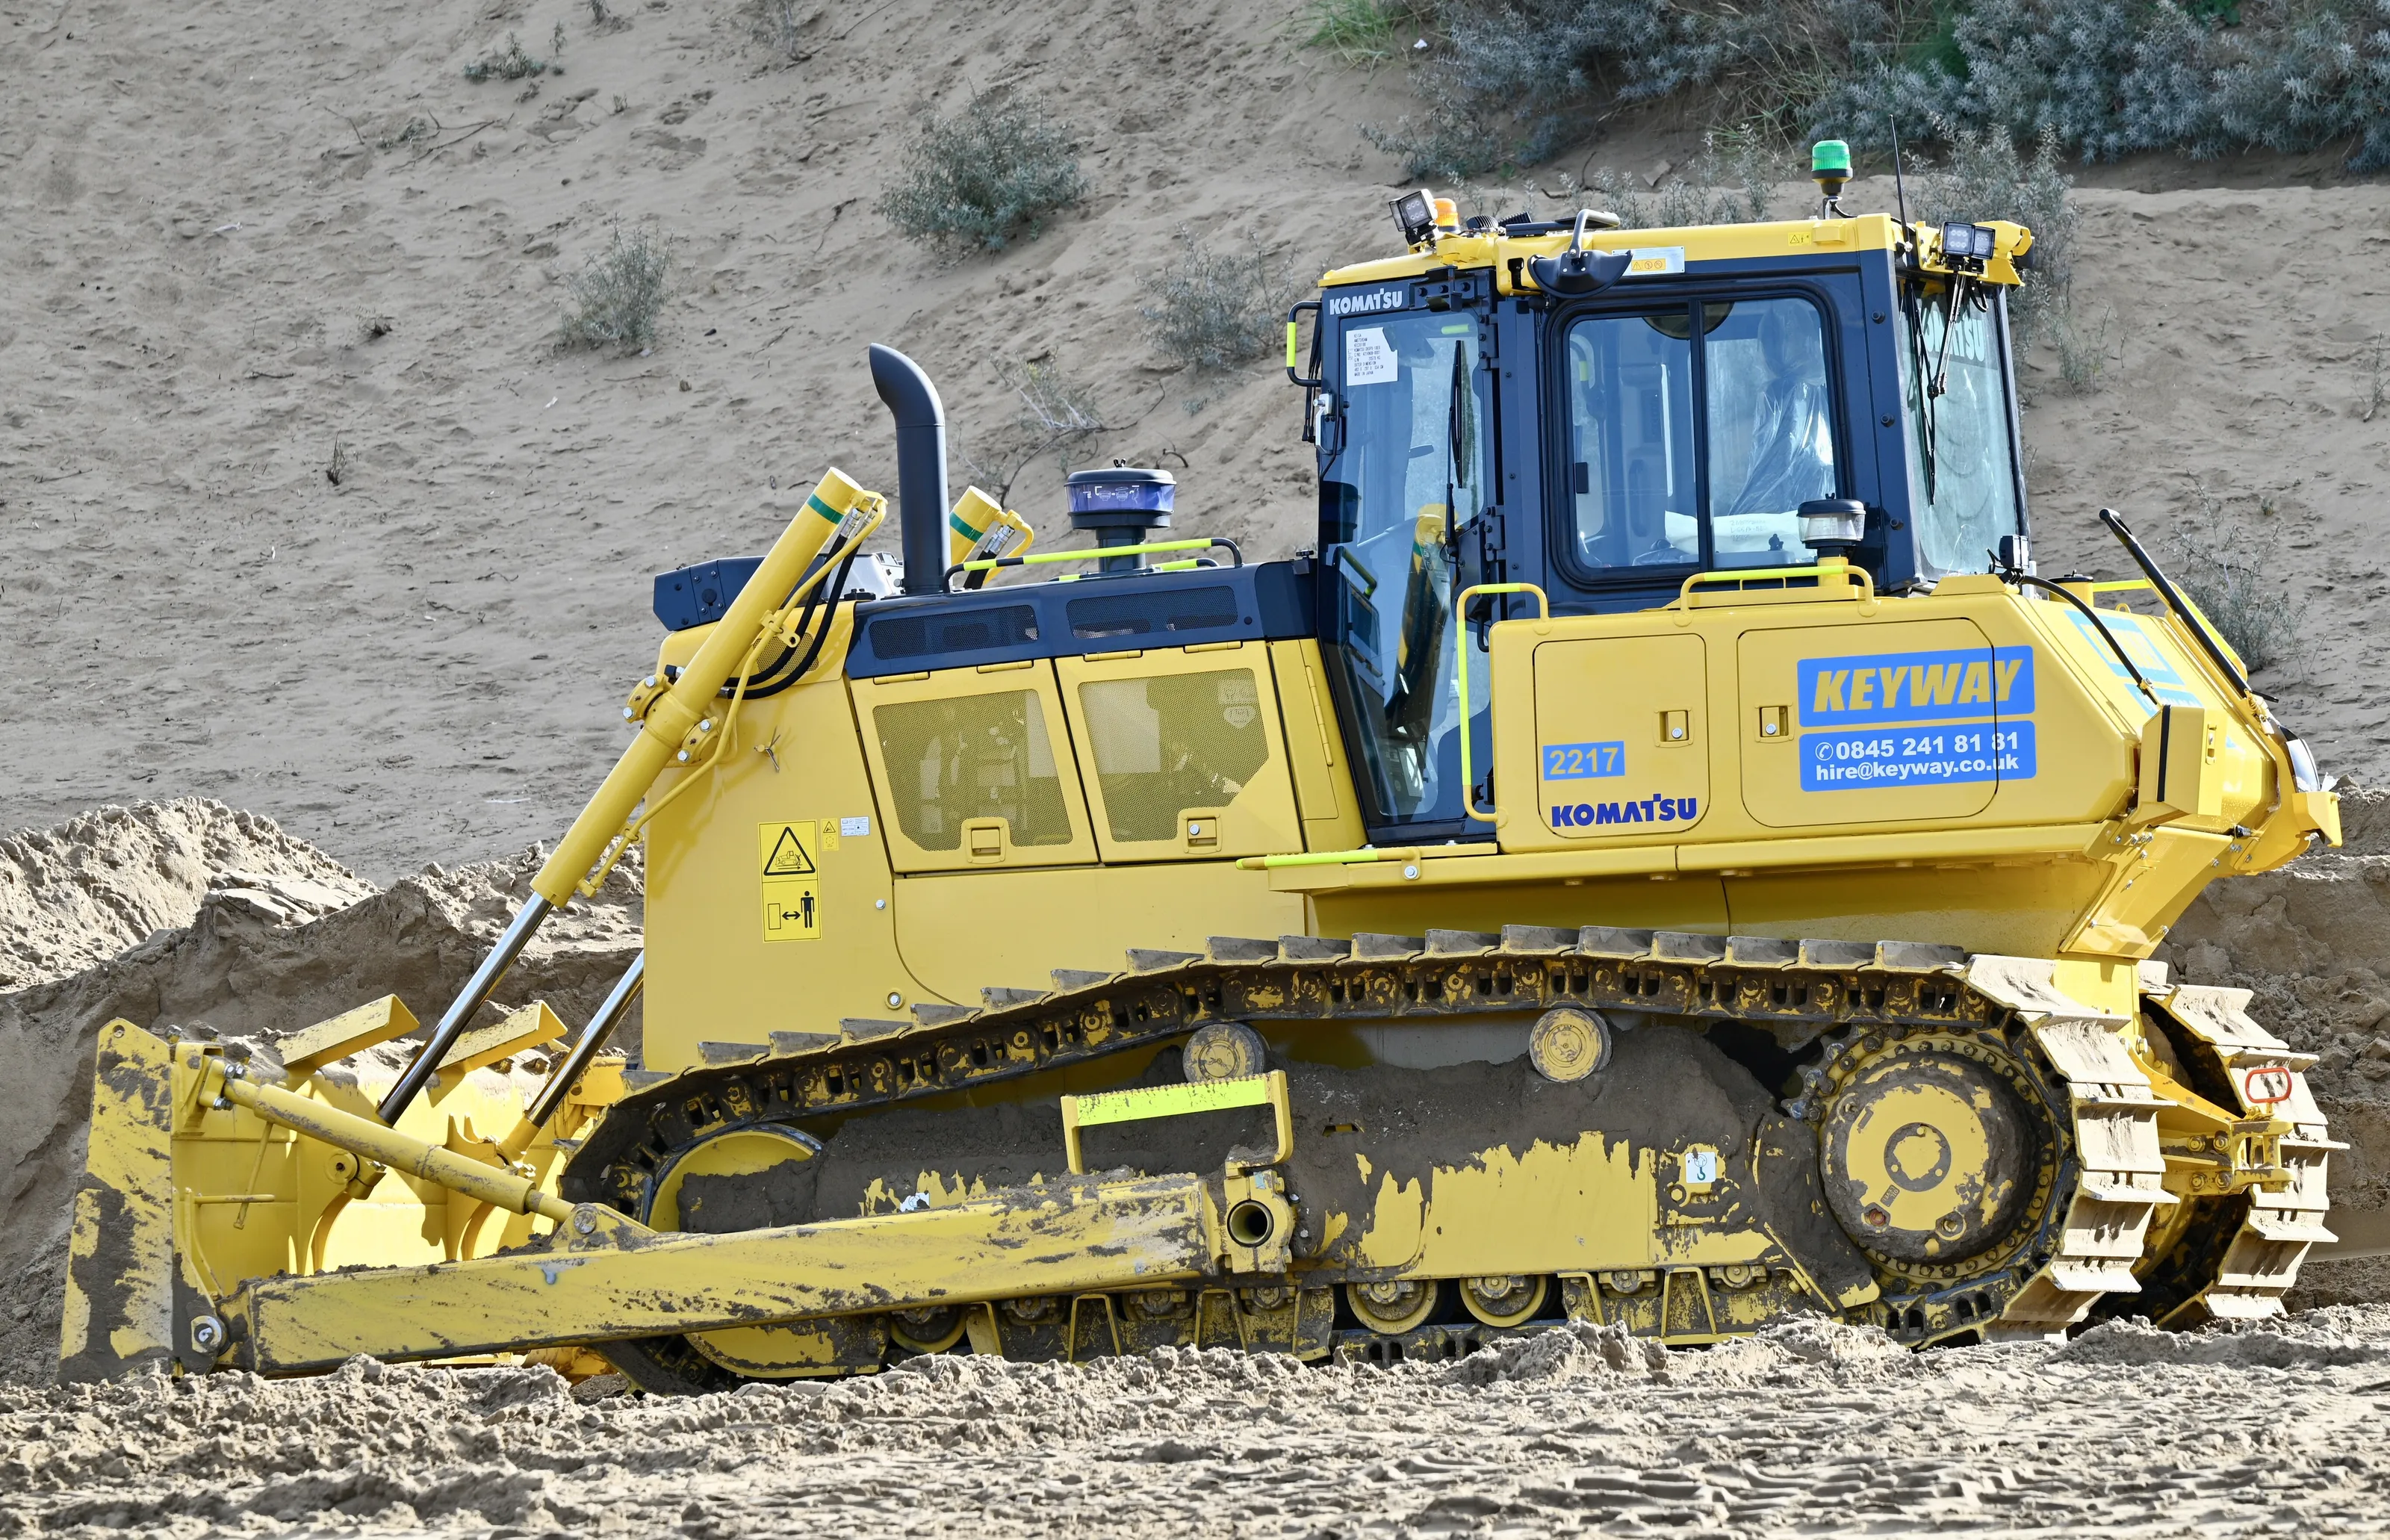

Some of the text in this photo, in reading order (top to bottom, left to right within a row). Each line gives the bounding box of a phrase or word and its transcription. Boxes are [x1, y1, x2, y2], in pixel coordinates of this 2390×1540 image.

[1329, 288, 1403, 315] KOMATSU
[1814, 659, 2023, 712] KEYWAY
[1836, 732, 2018, 760] 0845 241 81 81
[1550, 748, 1618, 774] 2217
[1816, 754, 2020, 780] hire@keyway.co.uk
[1552, 793, 1698, 828] KOMATSU
